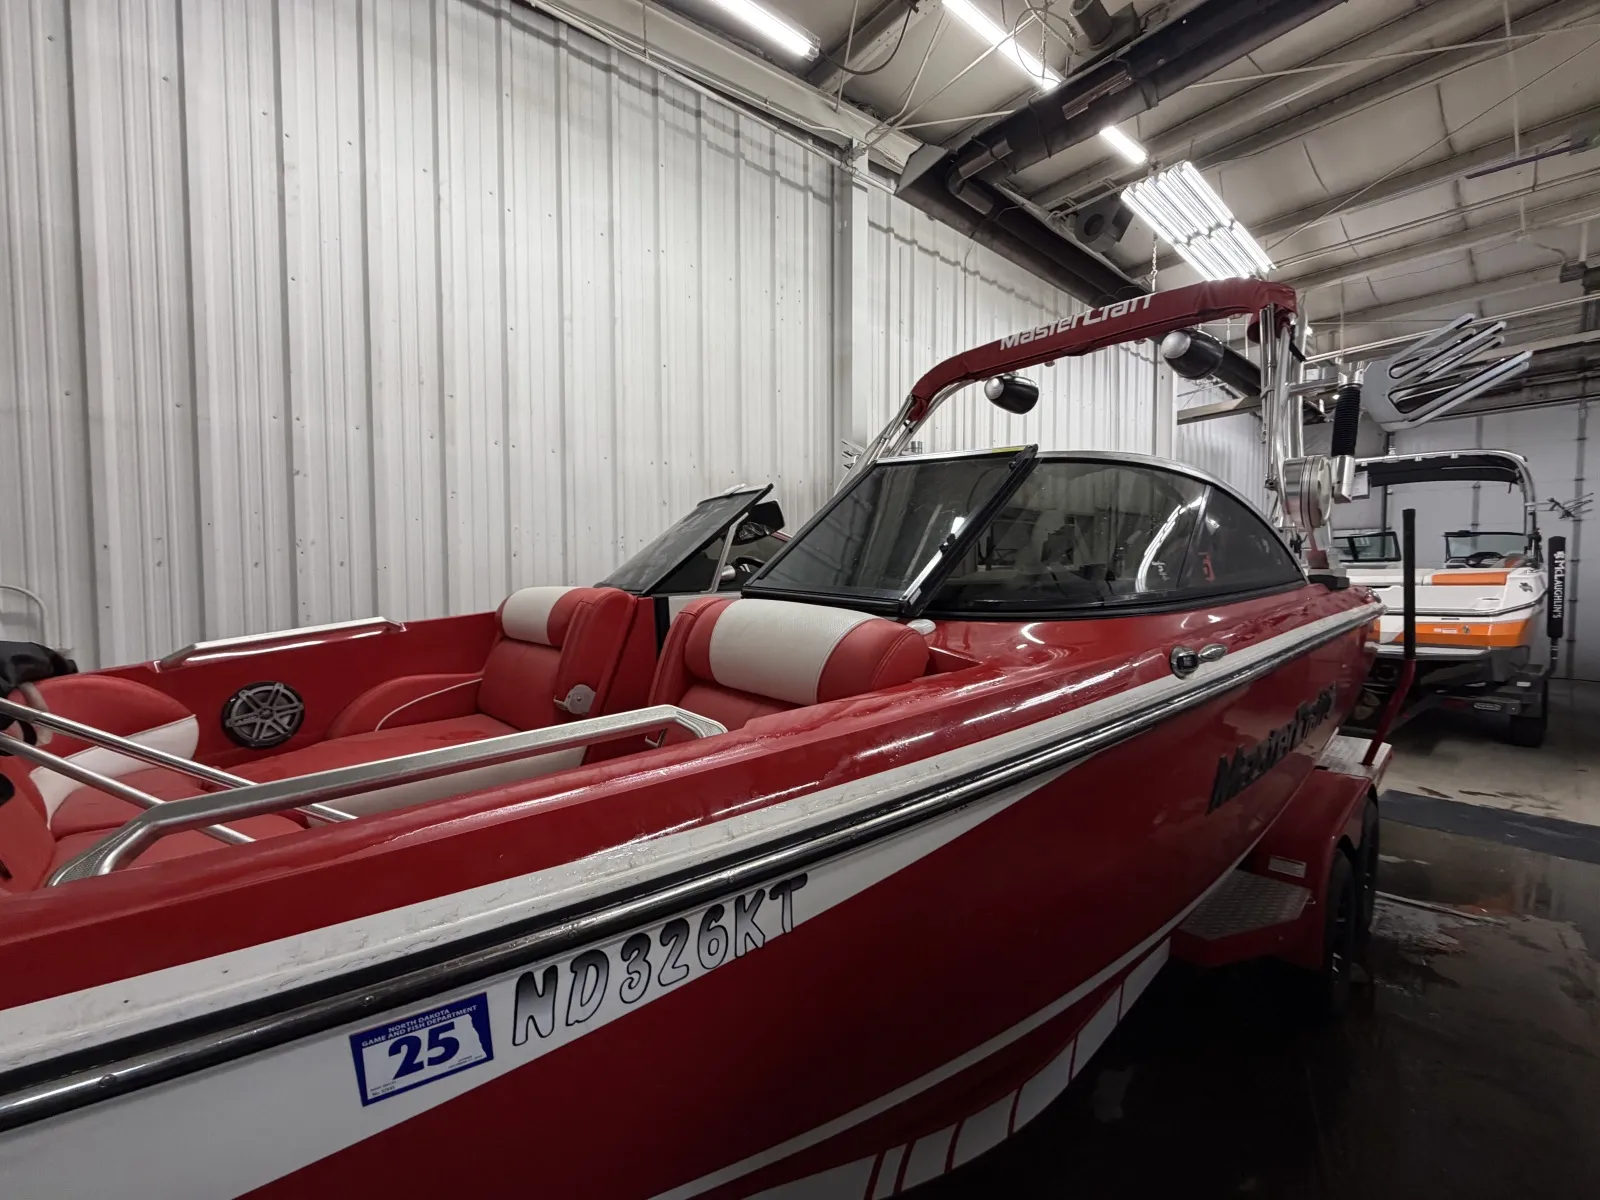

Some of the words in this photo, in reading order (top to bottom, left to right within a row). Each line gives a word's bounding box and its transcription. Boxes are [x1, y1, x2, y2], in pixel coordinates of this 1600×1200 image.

[512, 872, 808, 1047] ND326KT
[361, 1034, 387, 1048] GAME
[387, 1029, 406, 1040] AND
[407, 1022, 426, 1034] FISH
[426, 1004, 478, 1028] DEPARTMENT
[388, 1019, 417, 1033] NORTH
[418, 1008, 451, 1024] DAKOTA
[388, 1020, 460, 1081] 25
